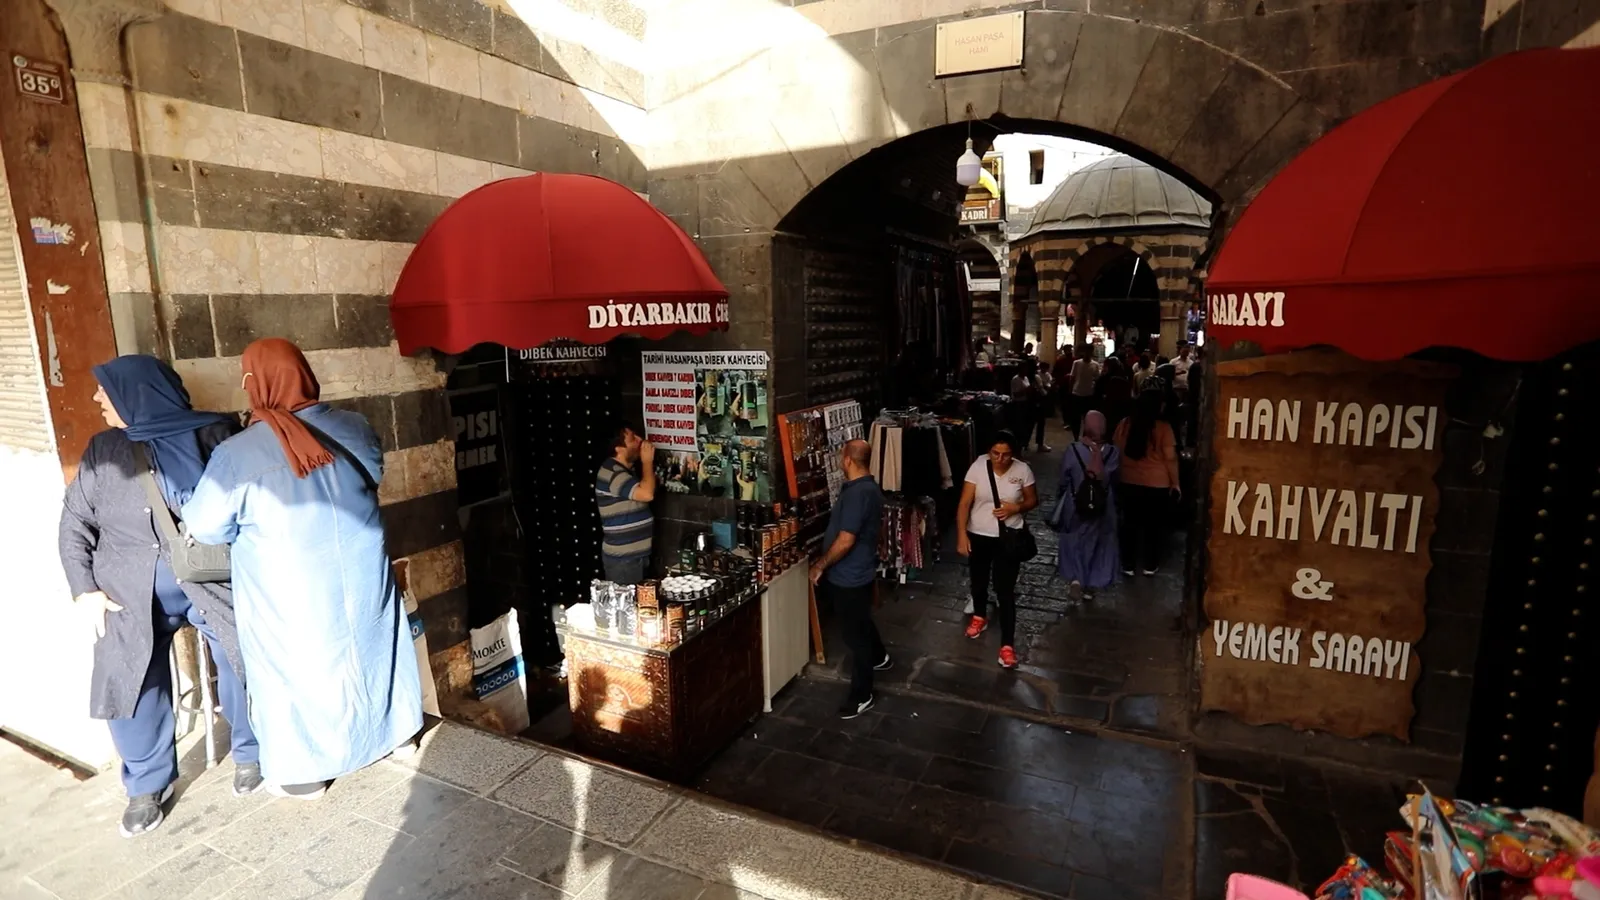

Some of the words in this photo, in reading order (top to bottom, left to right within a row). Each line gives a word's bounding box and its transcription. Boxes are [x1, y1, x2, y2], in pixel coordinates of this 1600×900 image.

[955, 34, 982, 46] HASAN
[588, 299, 712, 328] DİYARBAKIR
[1212, 291, 1285, 327] SARAYI
[665, 354, 704, 367] HASANPAŞA
[705, 353, 726, 365] DİBEK
[727, 353, 766, 365] KAHVECİSİ
[1227, 398, 1301, 442] HAN
[1313, 401, 1438, 450] KAPISI
[1222, 480, 1423, 553] KAHVALTI
[1291, 567, 1334, 600] &
[473, 637, 506, 659] MOKATE
[1213, 619, 1301, 665] YEMEK
[1309, 630, 1411, 681] SARAYI
